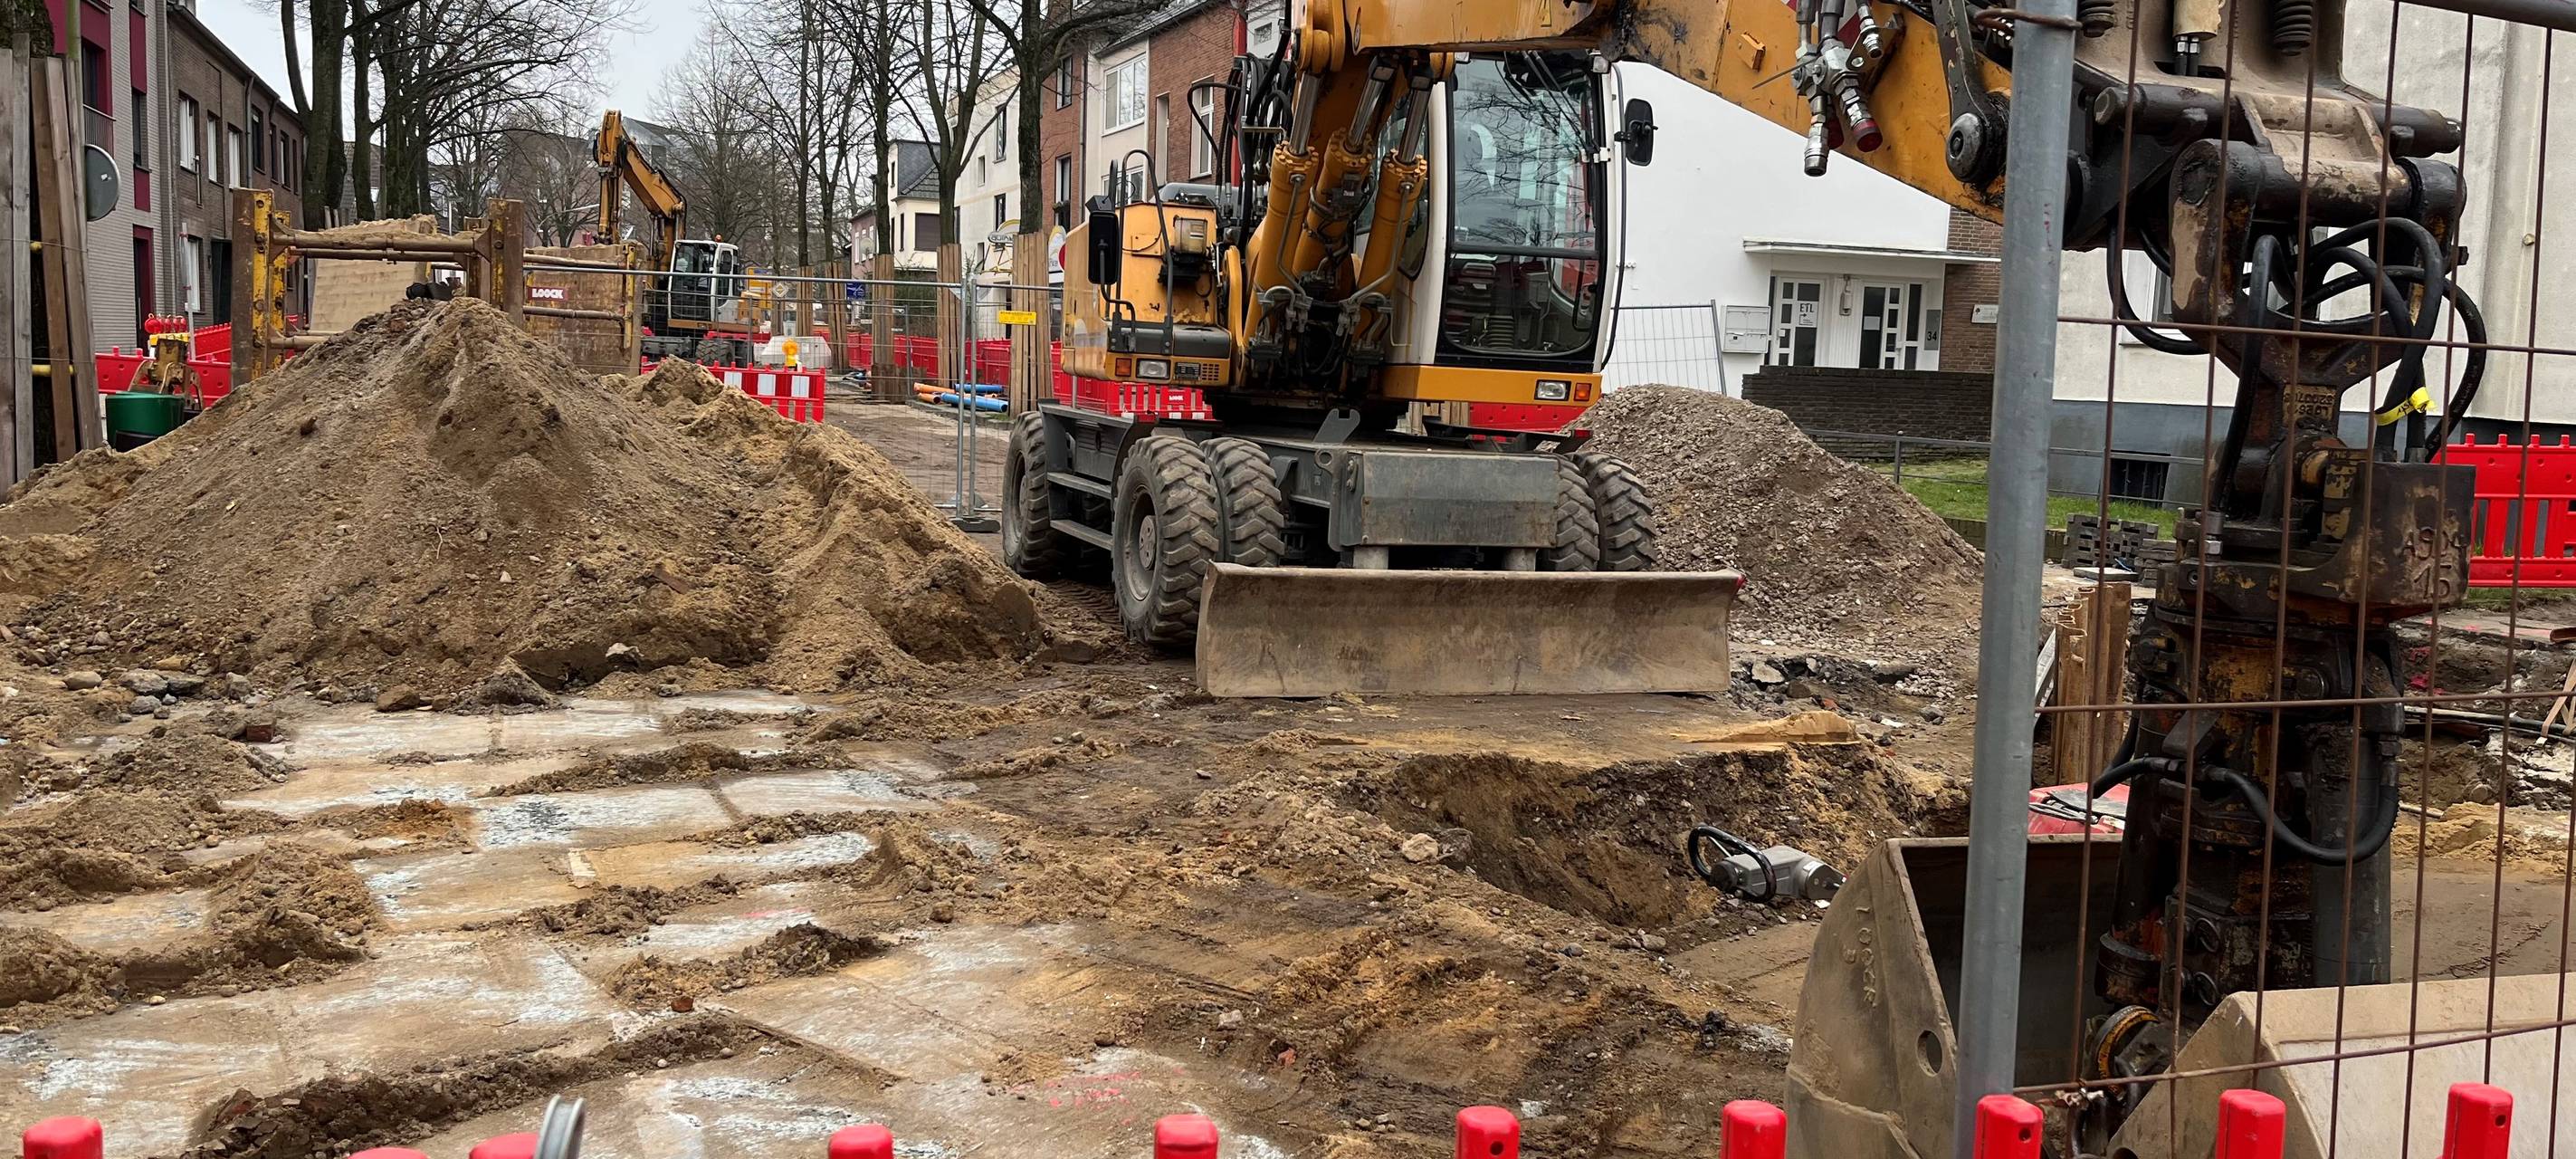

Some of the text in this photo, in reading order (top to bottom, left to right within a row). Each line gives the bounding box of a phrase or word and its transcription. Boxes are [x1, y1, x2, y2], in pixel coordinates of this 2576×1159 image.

[531, 288, 564, 299] LOOCK
[1799, 302, 1815, 313] ETL
[1926, 330, 1938, 341] 34
